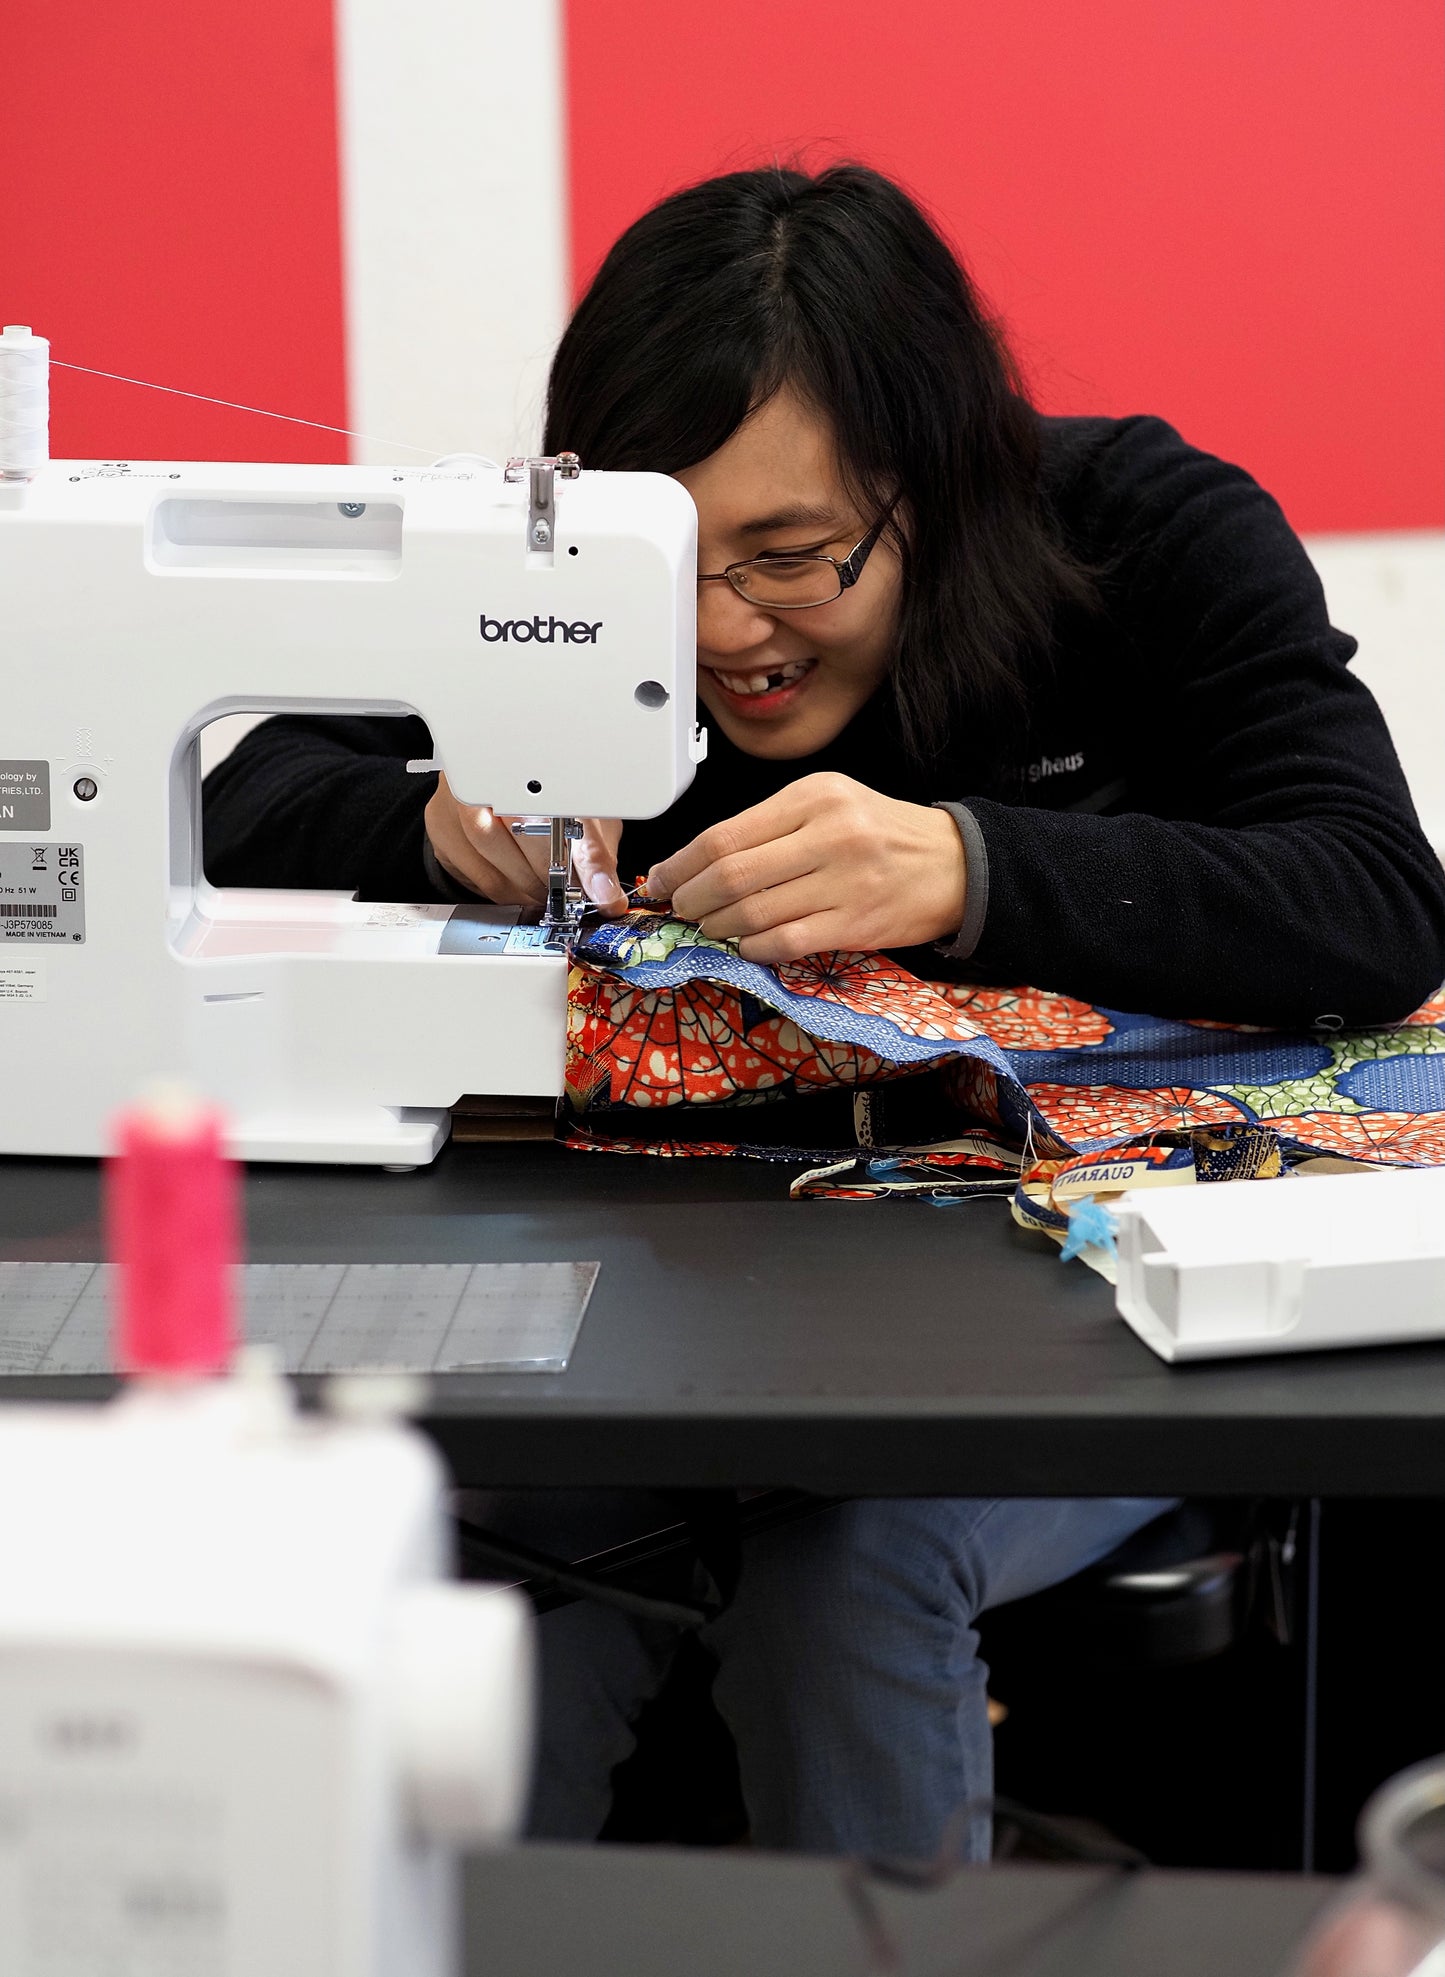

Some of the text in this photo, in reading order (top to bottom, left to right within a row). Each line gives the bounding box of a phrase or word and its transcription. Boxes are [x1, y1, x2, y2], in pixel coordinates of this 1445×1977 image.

[480, 614, 603, 644] brother
[1014, 752, 1084, 783] ghaus
[26, 772, 37, 782] by
[0, 805, 14, 818] N
[58, 847, 79, 857] UK
[58, 858, 79, 867] CA
[0, 920, 53, 930] -J3P579085
